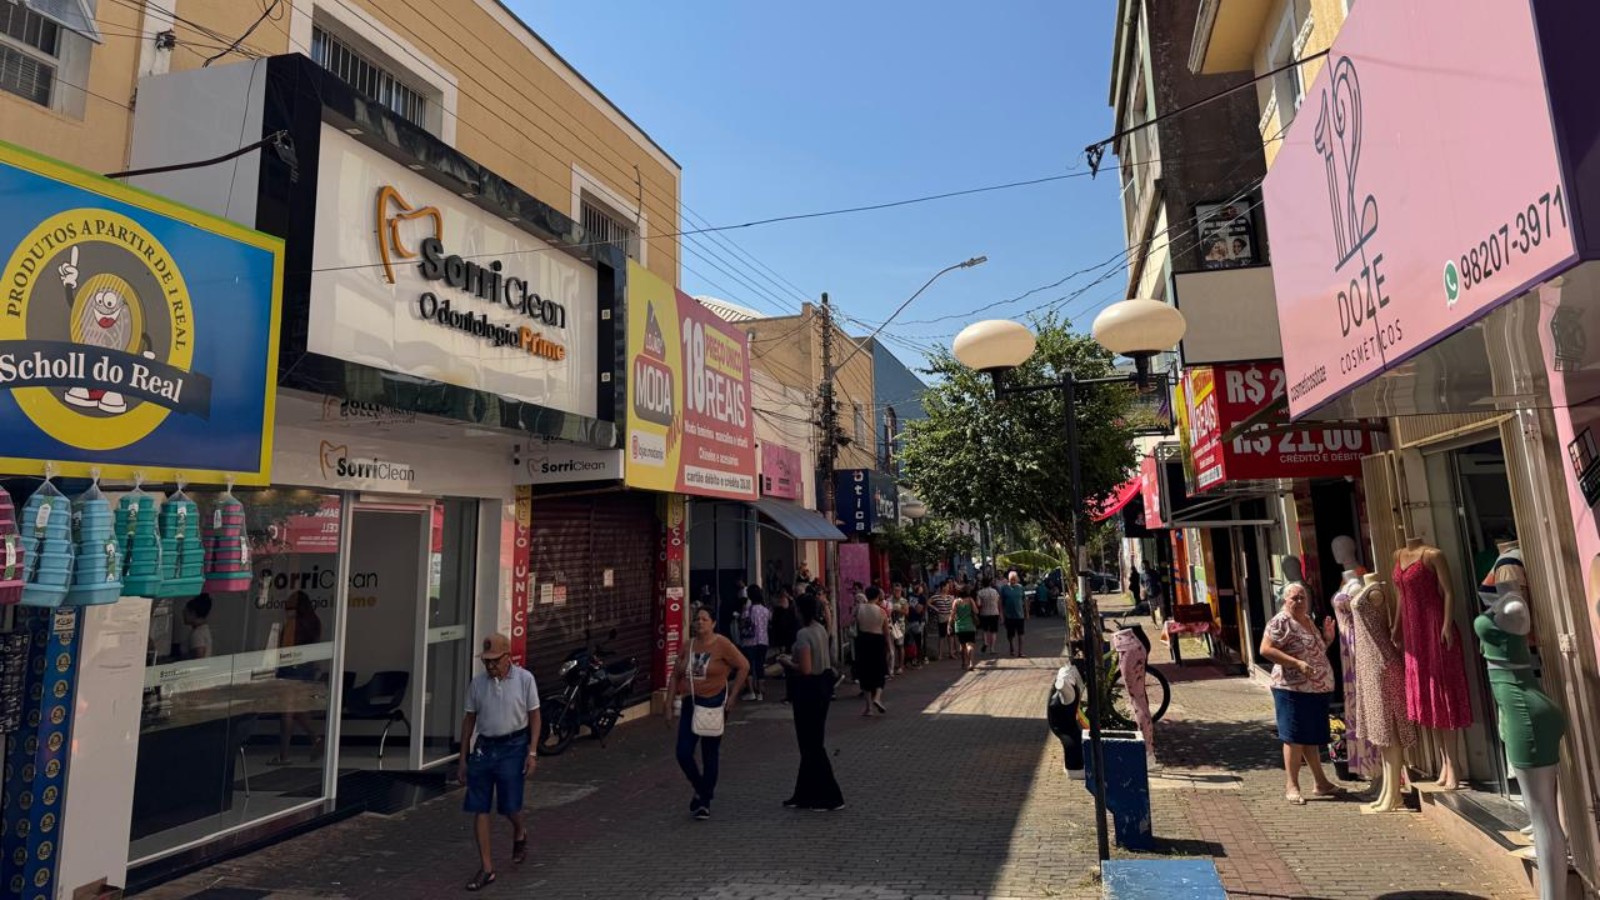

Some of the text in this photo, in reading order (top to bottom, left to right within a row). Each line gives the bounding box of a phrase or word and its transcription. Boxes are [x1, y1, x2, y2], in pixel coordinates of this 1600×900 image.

[1461, 184, 1567, 290] 98207-3971
[7, 222, 77, 318] PRODUTOS
[82, 219, 93, 236] A
[96, 219, 156, 262] PARTIR
[154, 257, 173, 285] DE
[172, 301, 187, 351] REAL
[1338, 253, 1390, 338] DOZE
[683, 317, 705, 414] 18
[1340, 319, 1403, 375] COSMÉTICOS
[0, 351, 183, 404] Scholl do Real
[636, 361, 672, 416] MODA
[705, 369, 746, 429] REAIS
[1225, 367, 1266, 405] R$
[337, 457, 415, 482] SorriClean
[541, 460, 606, 474] SorriClean
[1280, 452, 1321, 464] CRÉDITO
